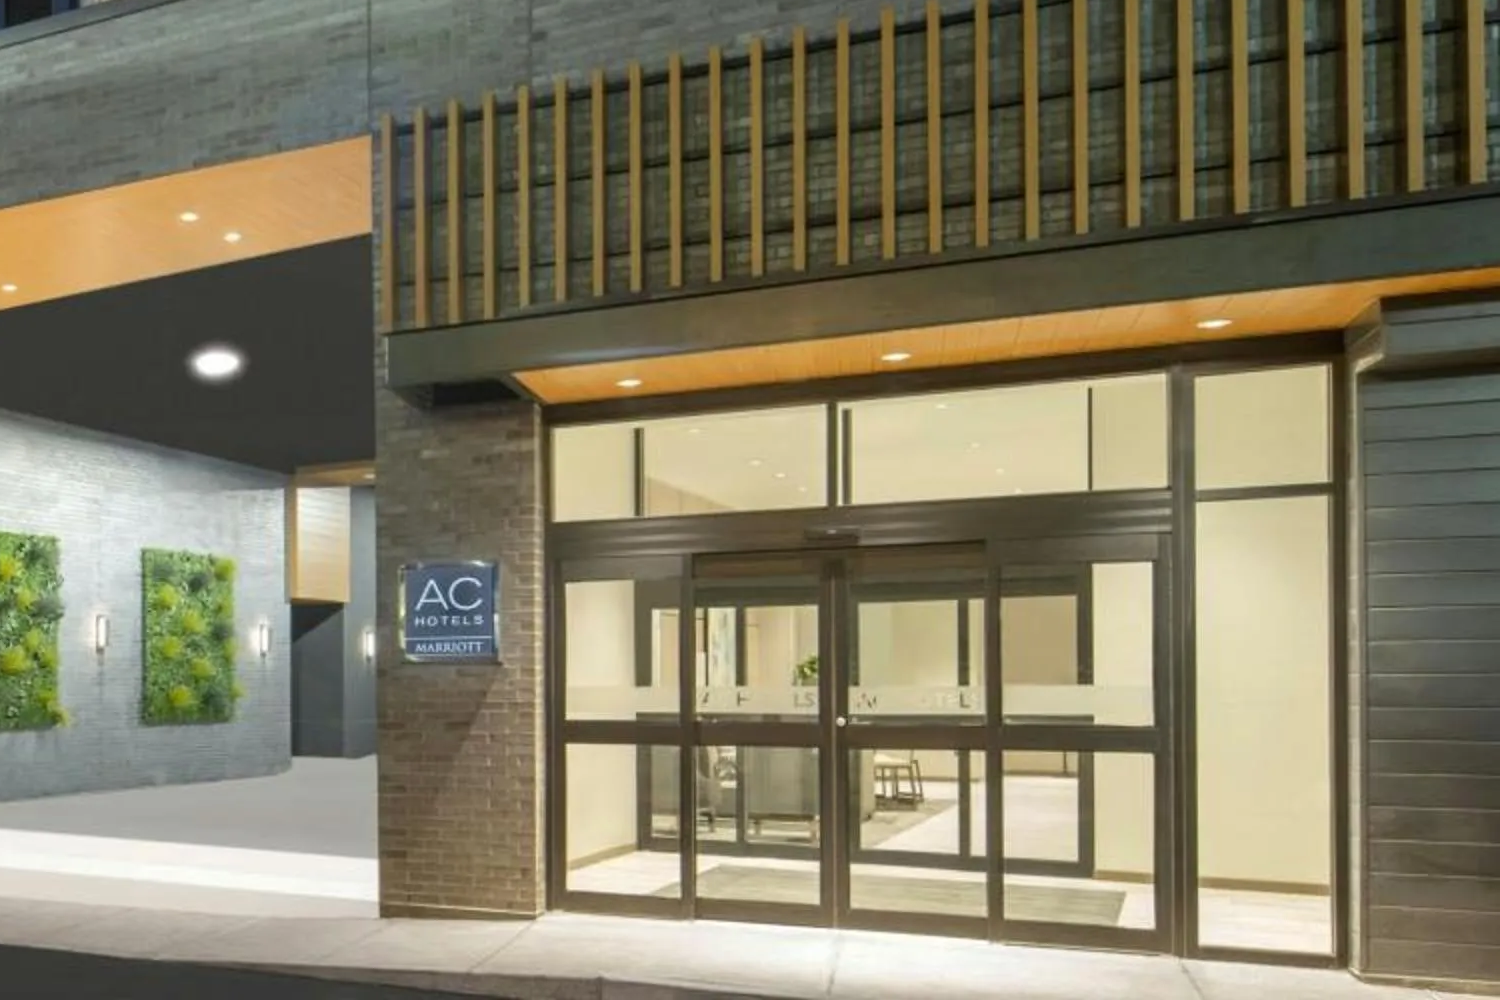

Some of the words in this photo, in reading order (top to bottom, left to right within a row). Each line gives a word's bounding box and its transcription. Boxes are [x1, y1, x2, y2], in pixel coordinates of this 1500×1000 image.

[415, 577, 483, 611] AC
[414, 615, 484, 627] HOTELS
[415, 641, 484, 653] MARRIOTT
